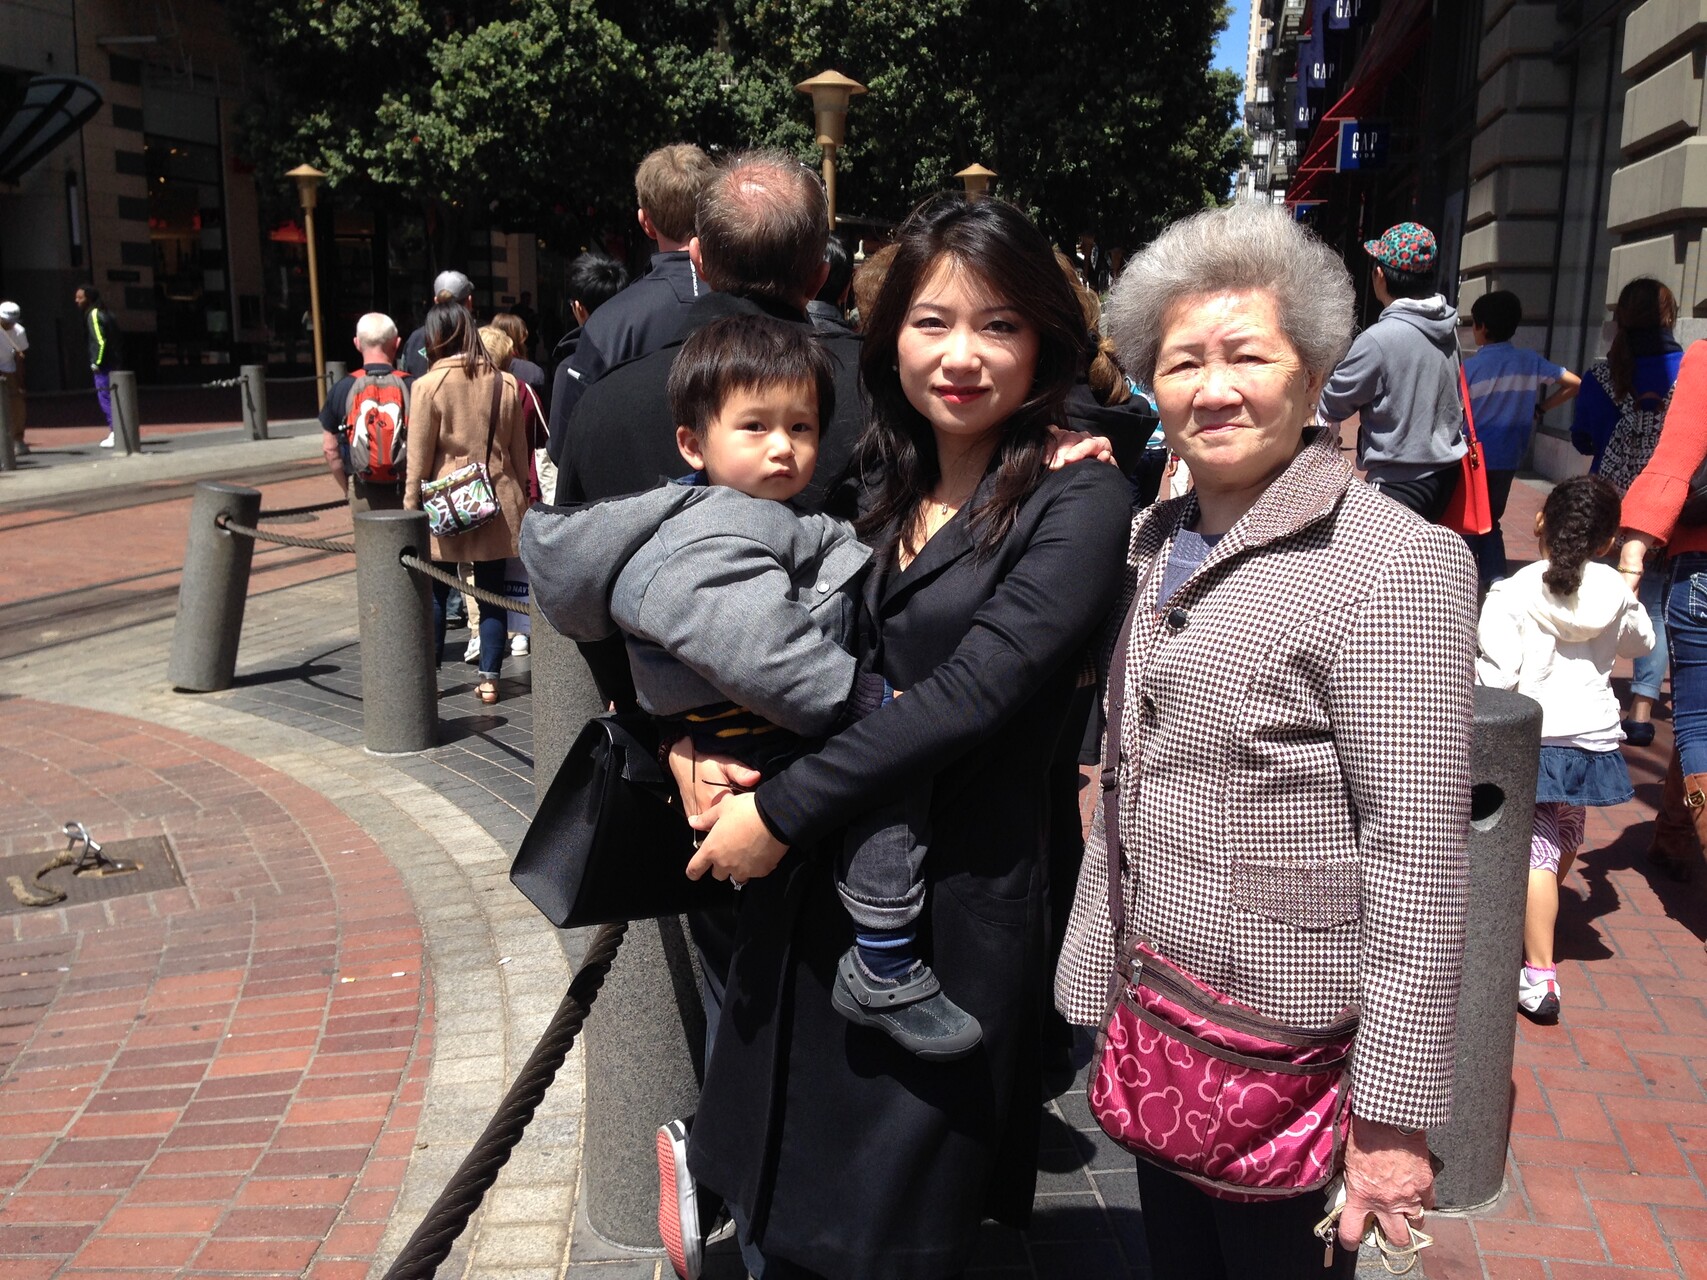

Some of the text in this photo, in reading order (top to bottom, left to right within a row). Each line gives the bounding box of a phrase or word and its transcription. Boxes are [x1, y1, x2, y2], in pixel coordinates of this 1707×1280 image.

[1335, 0, 1362, 18] GAP
[1313, 62, 1335, 80] GAP
[1298, 106, 1317, 121] GAP
[1352, 131, 1378, 152] GAP
